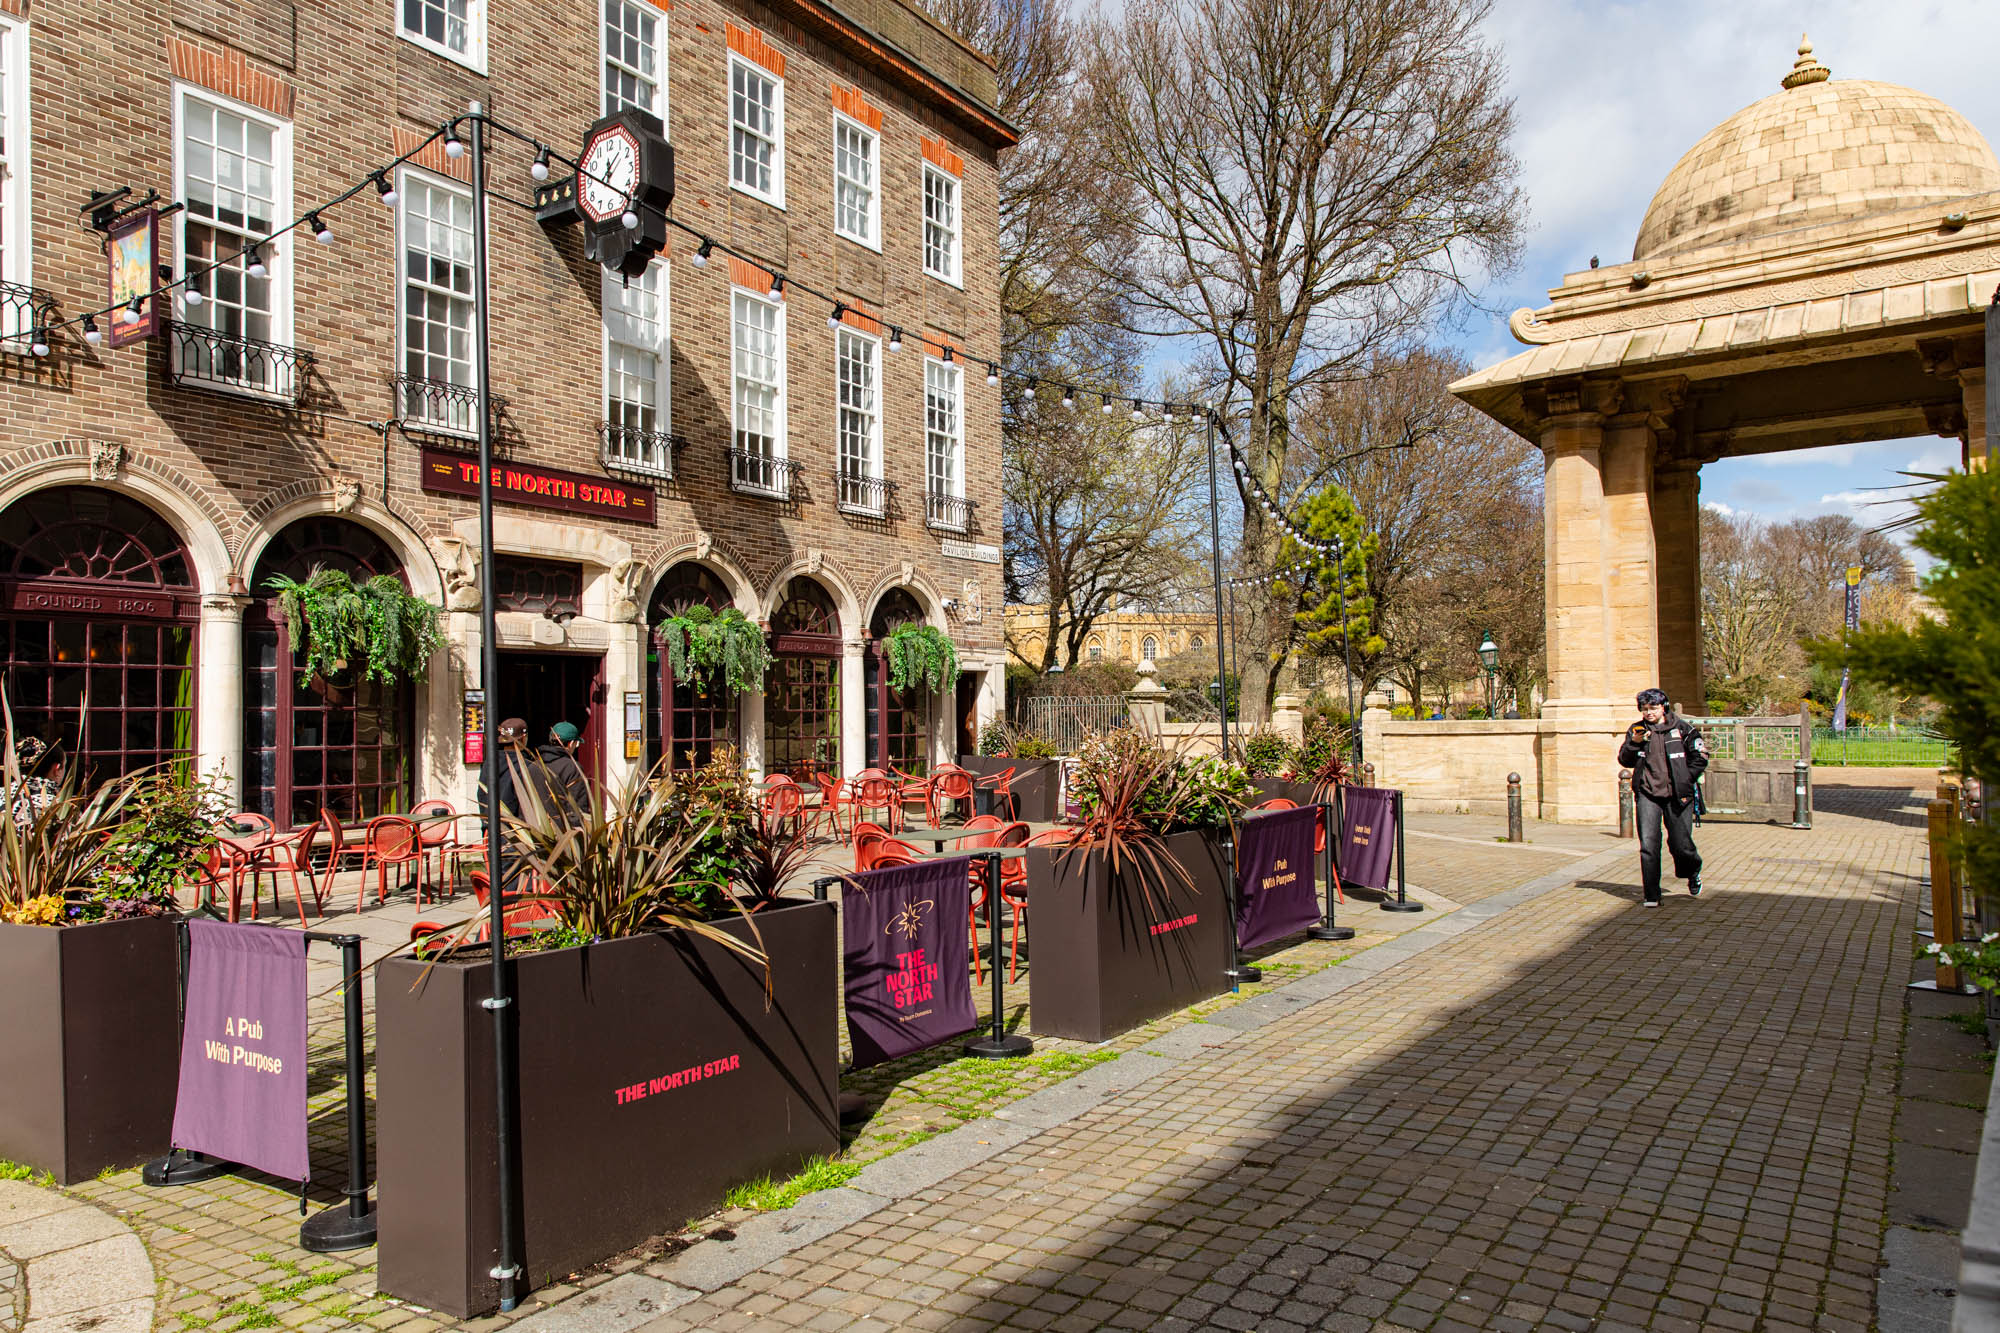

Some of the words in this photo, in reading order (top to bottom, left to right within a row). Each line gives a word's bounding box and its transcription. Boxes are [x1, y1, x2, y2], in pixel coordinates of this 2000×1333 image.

[606, 139, 614, 152] 12
[597, 147, 602, 159] 11
[625, 146, 630, 159] 2
[590, 161, 597, 172] 10
[628, 162, 634, 173] 3
[587, 178, 592, 188] 9
[625, 178, 631, 188] 4
[590, 191, 596, 202] 8
[597, 199, 603, 210] 7
[607, 199, 613, 210] 6
[458, 461, 502, 487] THE
[506, 472, 575, 500] NORTH
[579, 484, 627, 508] STAR
[943, 545, 970, 556] PAVILION
[970, 550, 998, 562] BUILDINGS
[26, 593, 102, 610] FOUNDED
[117, 599, 157, 613] 1806
[544, 625, 553, 638] 2
[1262, 876, 1276, 890] With
[1275, 872, 1296, 886] Purpose
[896, 949, 925, 970] THE
[886, 962, 938, 993] NORTH
[895, 984, 933, 1008] STAR
[226, 1017, 235, 1036] A
[238, 1018, 263, 1040] Pub
[205, 1039, 230, 1064] With
[233, 1046, 282, 1074] Purpose
[615, 1081, 647, 1105] THE
[649, 1065, 702, 1096] NORTH
[703, 1054, 740, 1079] STAR
